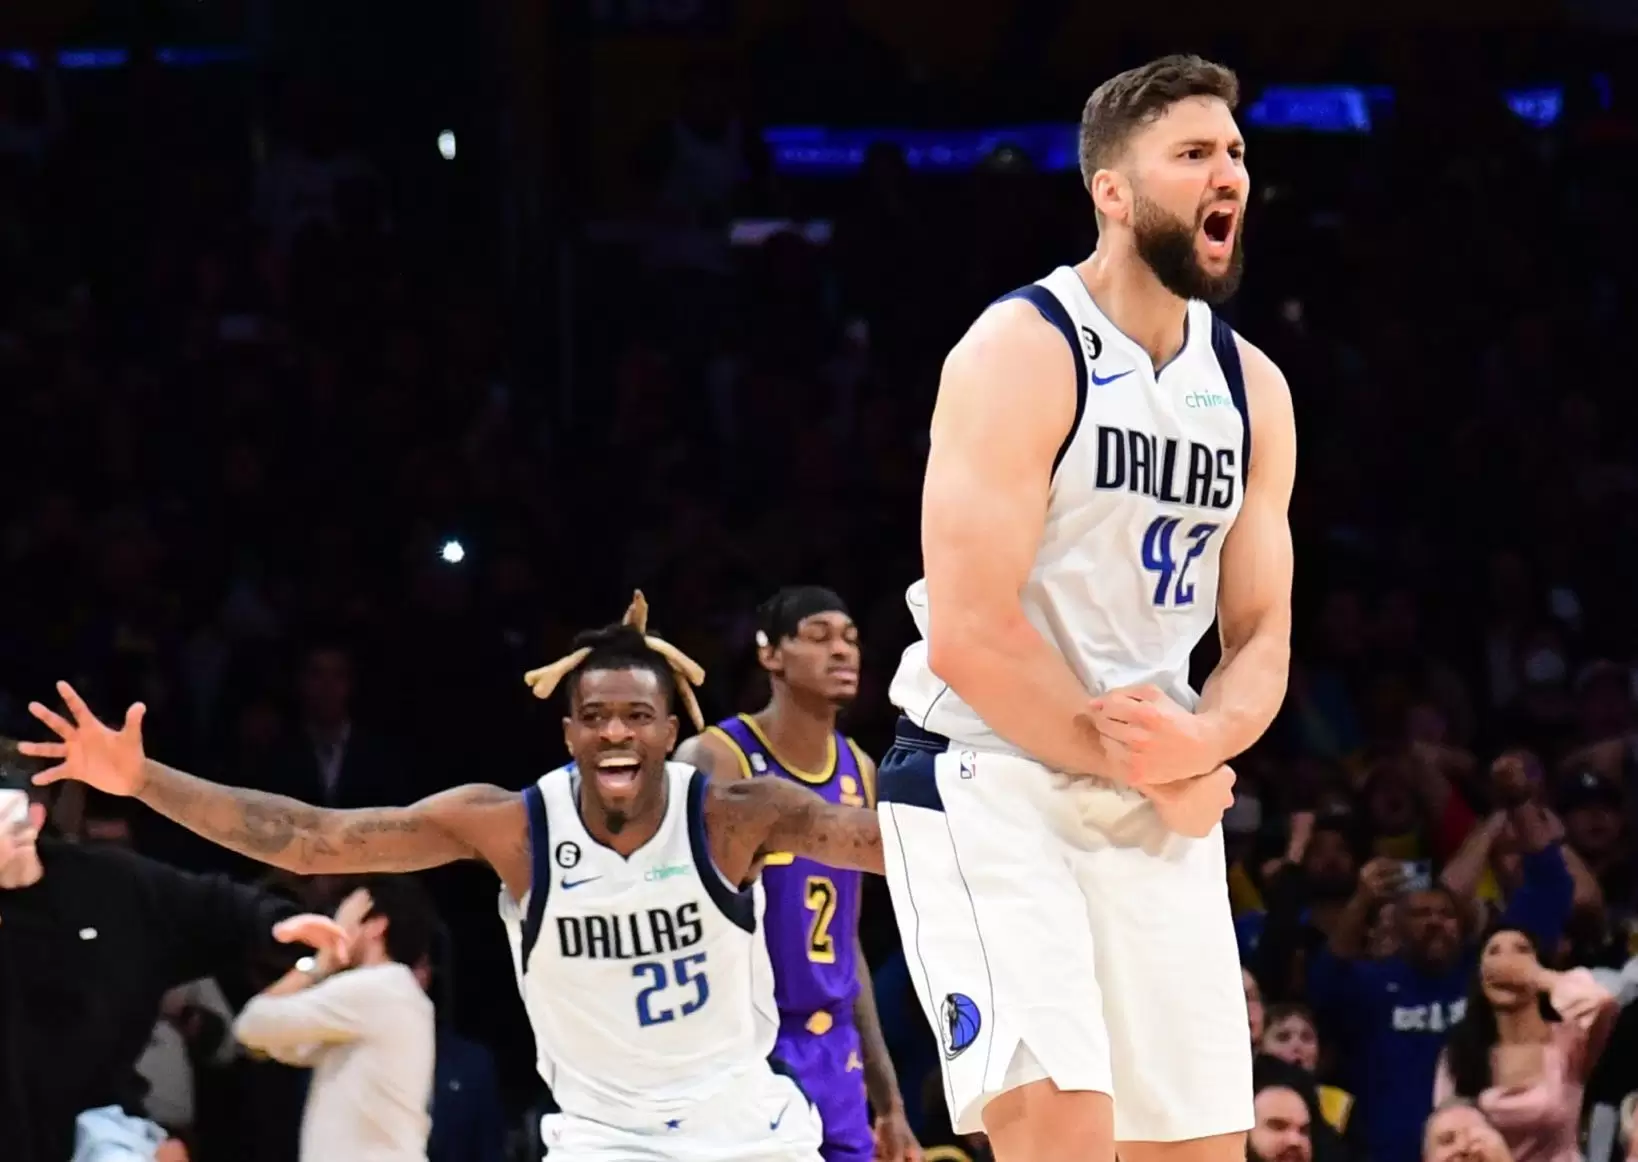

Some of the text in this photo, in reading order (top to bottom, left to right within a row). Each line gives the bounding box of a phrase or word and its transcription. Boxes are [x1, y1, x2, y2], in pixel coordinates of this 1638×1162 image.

[1095, 424, 1235, 509] DALLAS
[1141, 515, 1221, 607] 42
[557, 842, 579, 867] 6
[555, 901, 703, 959] DALLAS
[804, 875, 836, 963] 2
[631, 951, 710, 1027] 25
